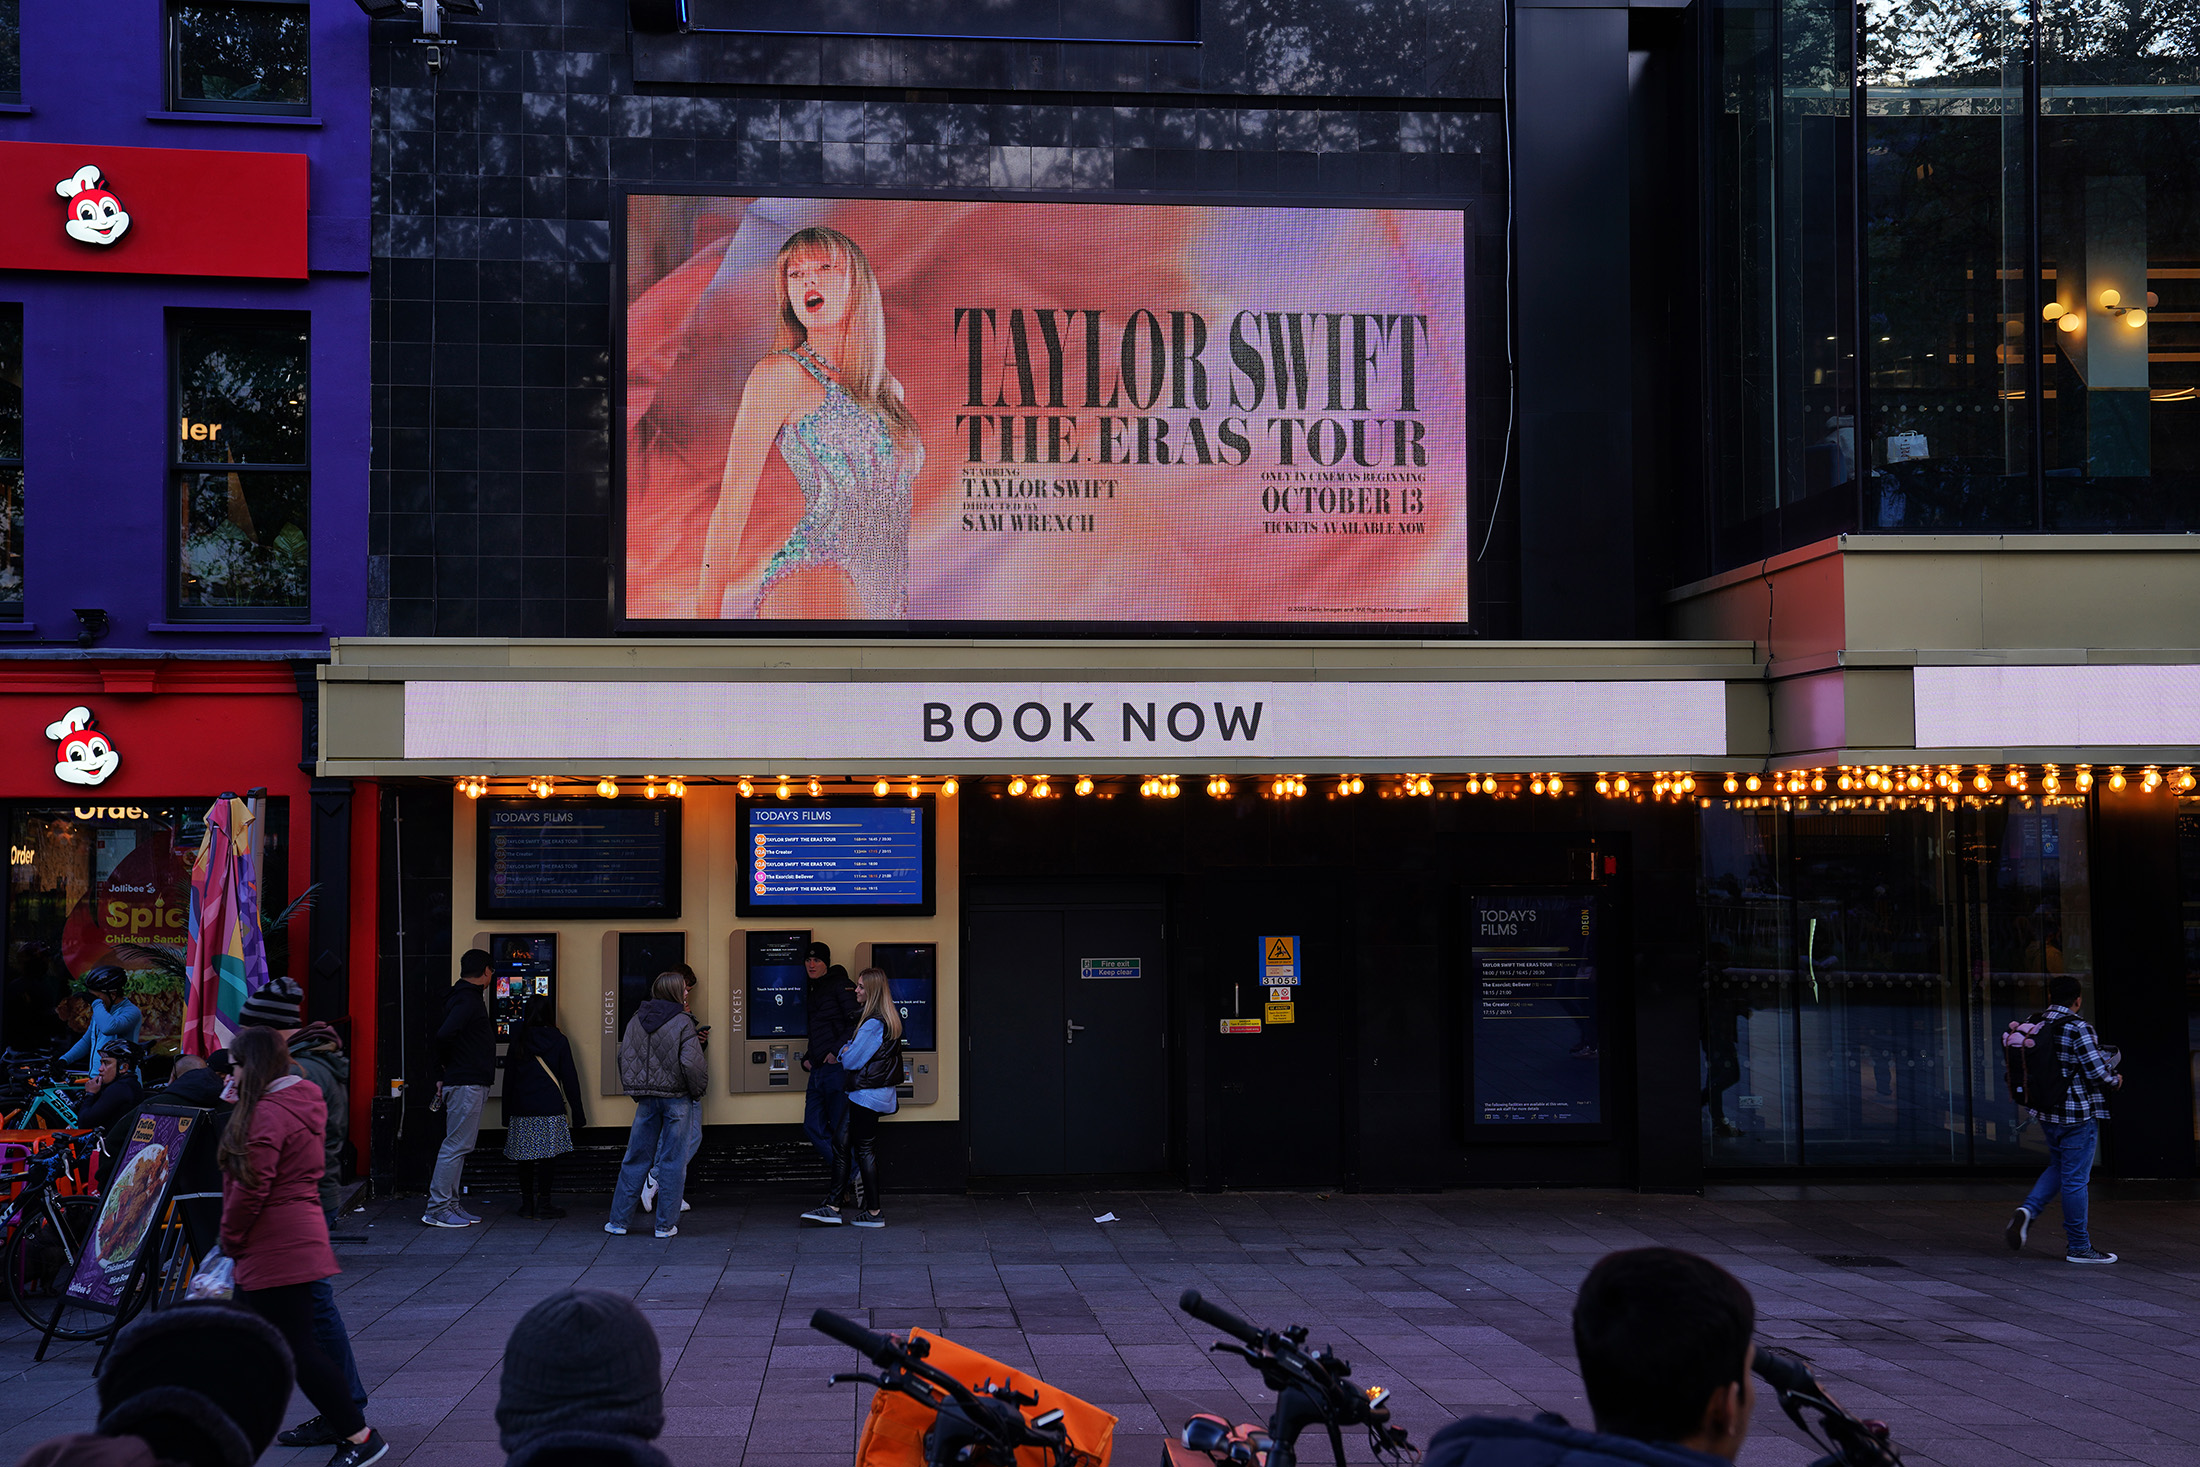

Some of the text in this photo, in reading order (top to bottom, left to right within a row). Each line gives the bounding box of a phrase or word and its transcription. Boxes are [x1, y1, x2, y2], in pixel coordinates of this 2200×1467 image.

[954, 308, 1429, 413] TAYLOR SWIFT
[956, 415, 1430, 467] THE ERAS TOUR
[962, 468, 1020, 477] STARRING
[1261, 472, 1426, 482] ONLY IN CINEMAS BEGINNING
[962, 478, 1119, 498] TAYLOR SWIFT
[1262, 486, 1424, 514] OCTOBER 13
[962, 502, 1038, 511] DIRECTED BY
[962, 514, 1095, 532] SAM WRENCH
[1263, 522, 1426, 534] TICKETS AVAILABLE NOW
[923, 702, 1263, 742] BOOK NOW
[496, 812, 574, 822] TODAY'S FILMS
[756, 811, 832, 821] TODAY'S FILMS
[10, 845, 36, 866] Order
[108, 884, 145, 893] Jollibee
[1480, 910, 1537, 922] TODAY'S
[1581, 909, 1590, 936] ODEON
[1480, 924, 1518, 936] FILMS
[105, 934, 150, 944] Chicken
[605, 990, 614, 1034] TICKETS
[733, 988, 742, 1032] TICKETS
[105, 1262, 124, 1274] Chicken
[108, 1276, 120, 1286] Rice
[68, 1282, 86, 1294] Jollibee
